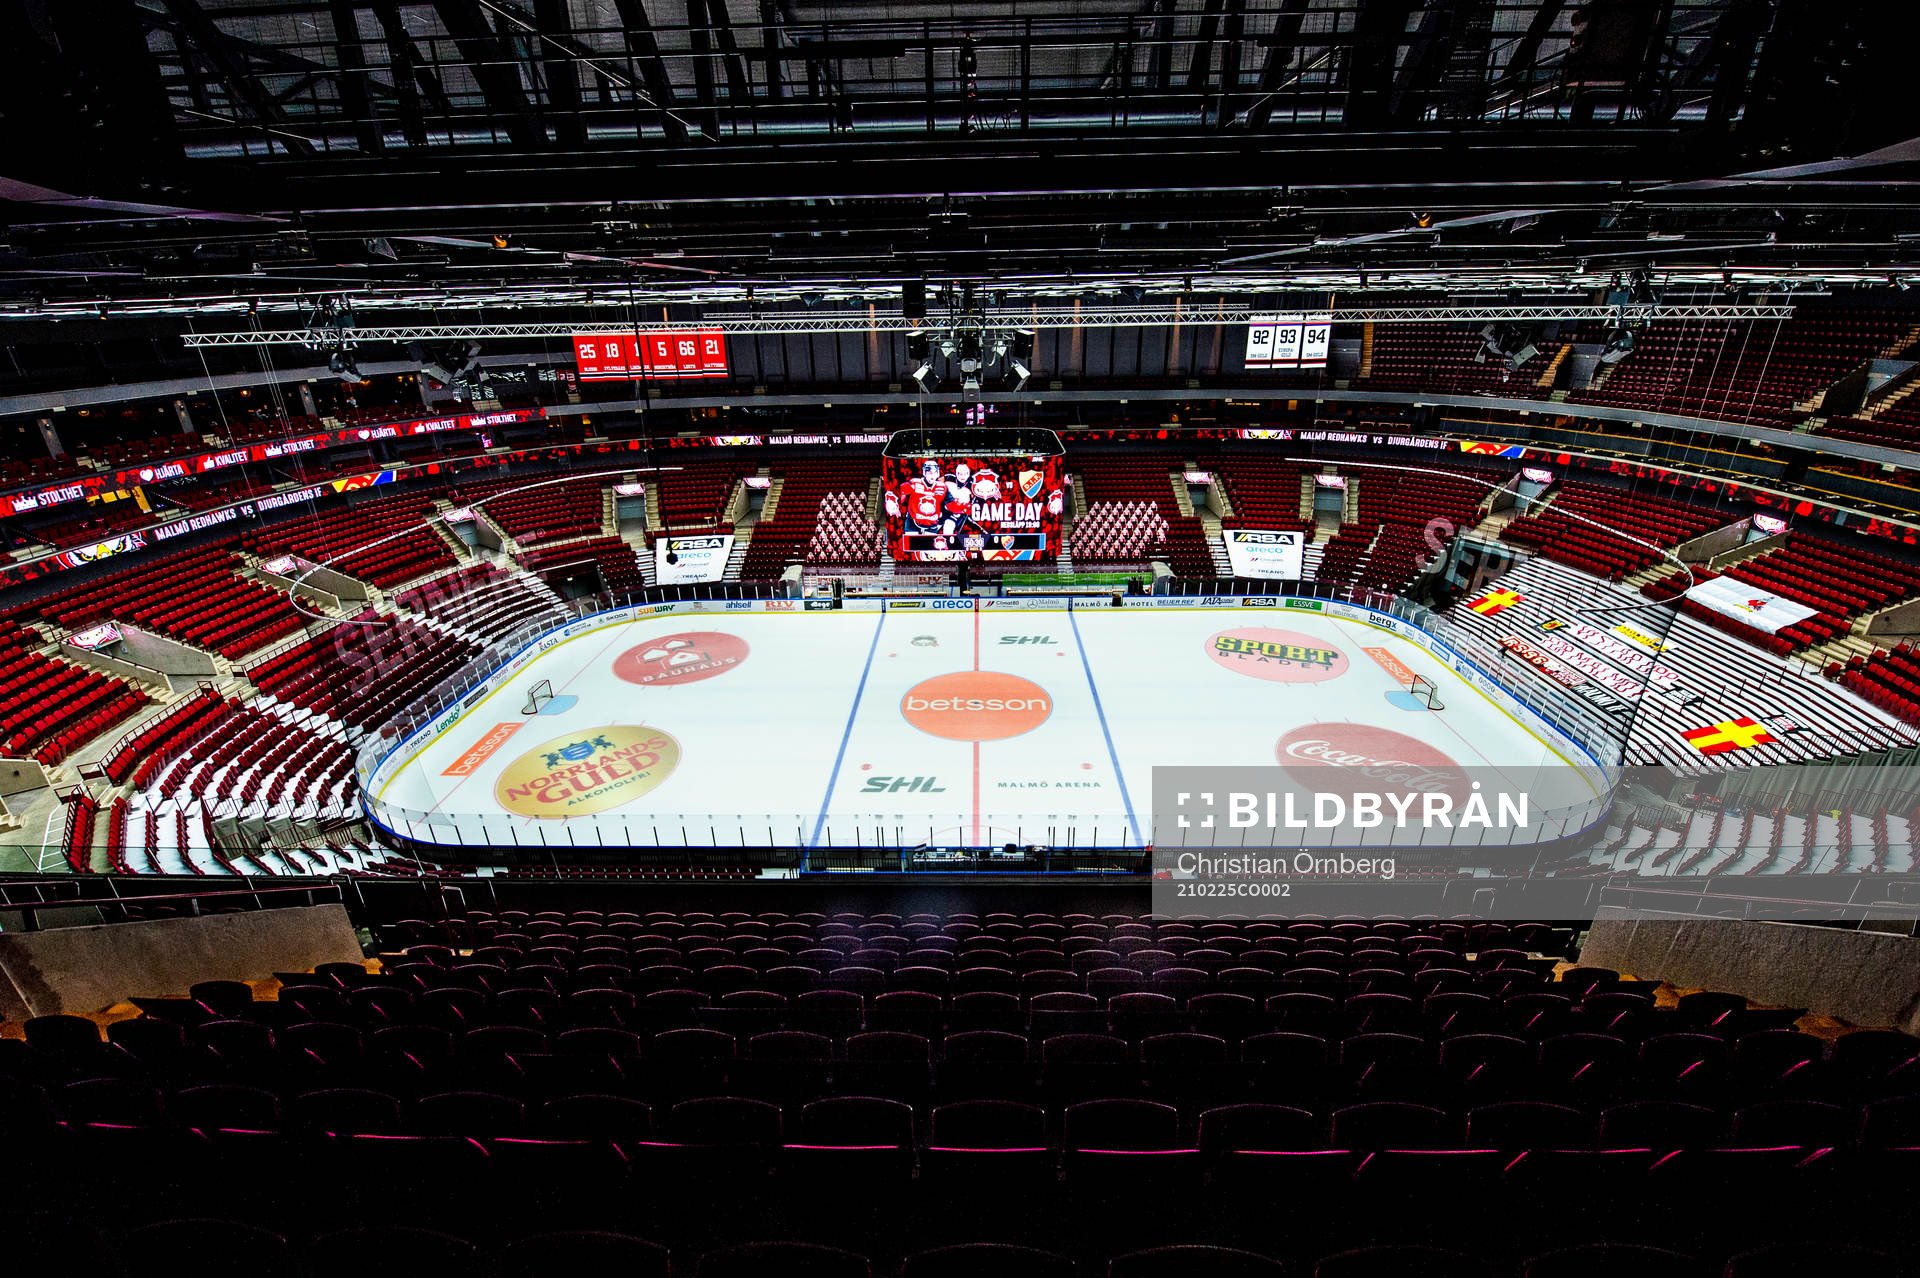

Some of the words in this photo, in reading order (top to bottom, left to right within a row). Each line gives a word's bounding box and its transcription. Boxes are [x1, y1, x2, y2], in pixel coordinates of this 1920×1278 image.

[1252, 330, 1269, 344] 92
[1280, 329, 1296, 344] 93
[1308, 329, 1326, 344] 94
[579, 344, 596, 358] 25
[605, 343, 619, 358] 18
[657, 342, 667, 356] 5
[678, 341, 696, 356] 66
[705, 340, 720, 354] 21
[425, 419, 455, 432] KVALITET
[487, 414, 516, 424] STOLTHET
[371, 427, 396, 439] HJÄRTA
[793, 436, 828, 444] REDHAWKS
[1300, 430, 1326, 441] MALMÖ
[1327, 432, 1367, 444] REDHAWKS
[1388, 436, 1440, 449] DJURGÅRDENS
[1440, 440, 1448, 450] IF
[282, 440, 314, 454] STOLTHET
[214, 451, 248, 466] KVALITET
[155, 464, 184, 480] HJÄRTA
[37, 485, 84, 506] STOLTHET
[154, 520, 190, 541] MALMÖ
[190, 508, 236, 532] REDHAWKS
[256, 488, 314, 512] DJURGÅRDENS
[314, 486, 322, 500] IF
[972, 502, 1012, 521] GAME
[1016, 502, 1044, 521] DAY
[679, 538, 722, 549] RSA
[950, 536, 954, 544] 0
[994, 536, 998, 544] 0
[1246, 534, 1292, 544] RSA
[932, 600, 972, 608] areco
[1249, 598, 1276, 606] RSA
[1293, 600, 1314, 608] ESSVE
[638, 604, 676, 616] SUBWAY
[1369, 612, 1397, 628] bergx
[998, 636, 1059, 644] SHL
[1214, 636, 1341, 667] SPORT
[1218, 652, 1333, 671] BLADET
[1368, 648, 1413, 684] betsson
[642, 656, 737, 683] BAUHAUS
[906, 696, 1047, 712] betsson
[436, 712, 460, 734] Lendo
[450, 723, 517, 776] betsson
[504, 737, 669, 802] NORRLANDS
[536, 752, 661, 804] GULD
[860, 776, 946, 793] SHL
[567, 772, 652, 806] ALKOHOLFRI
